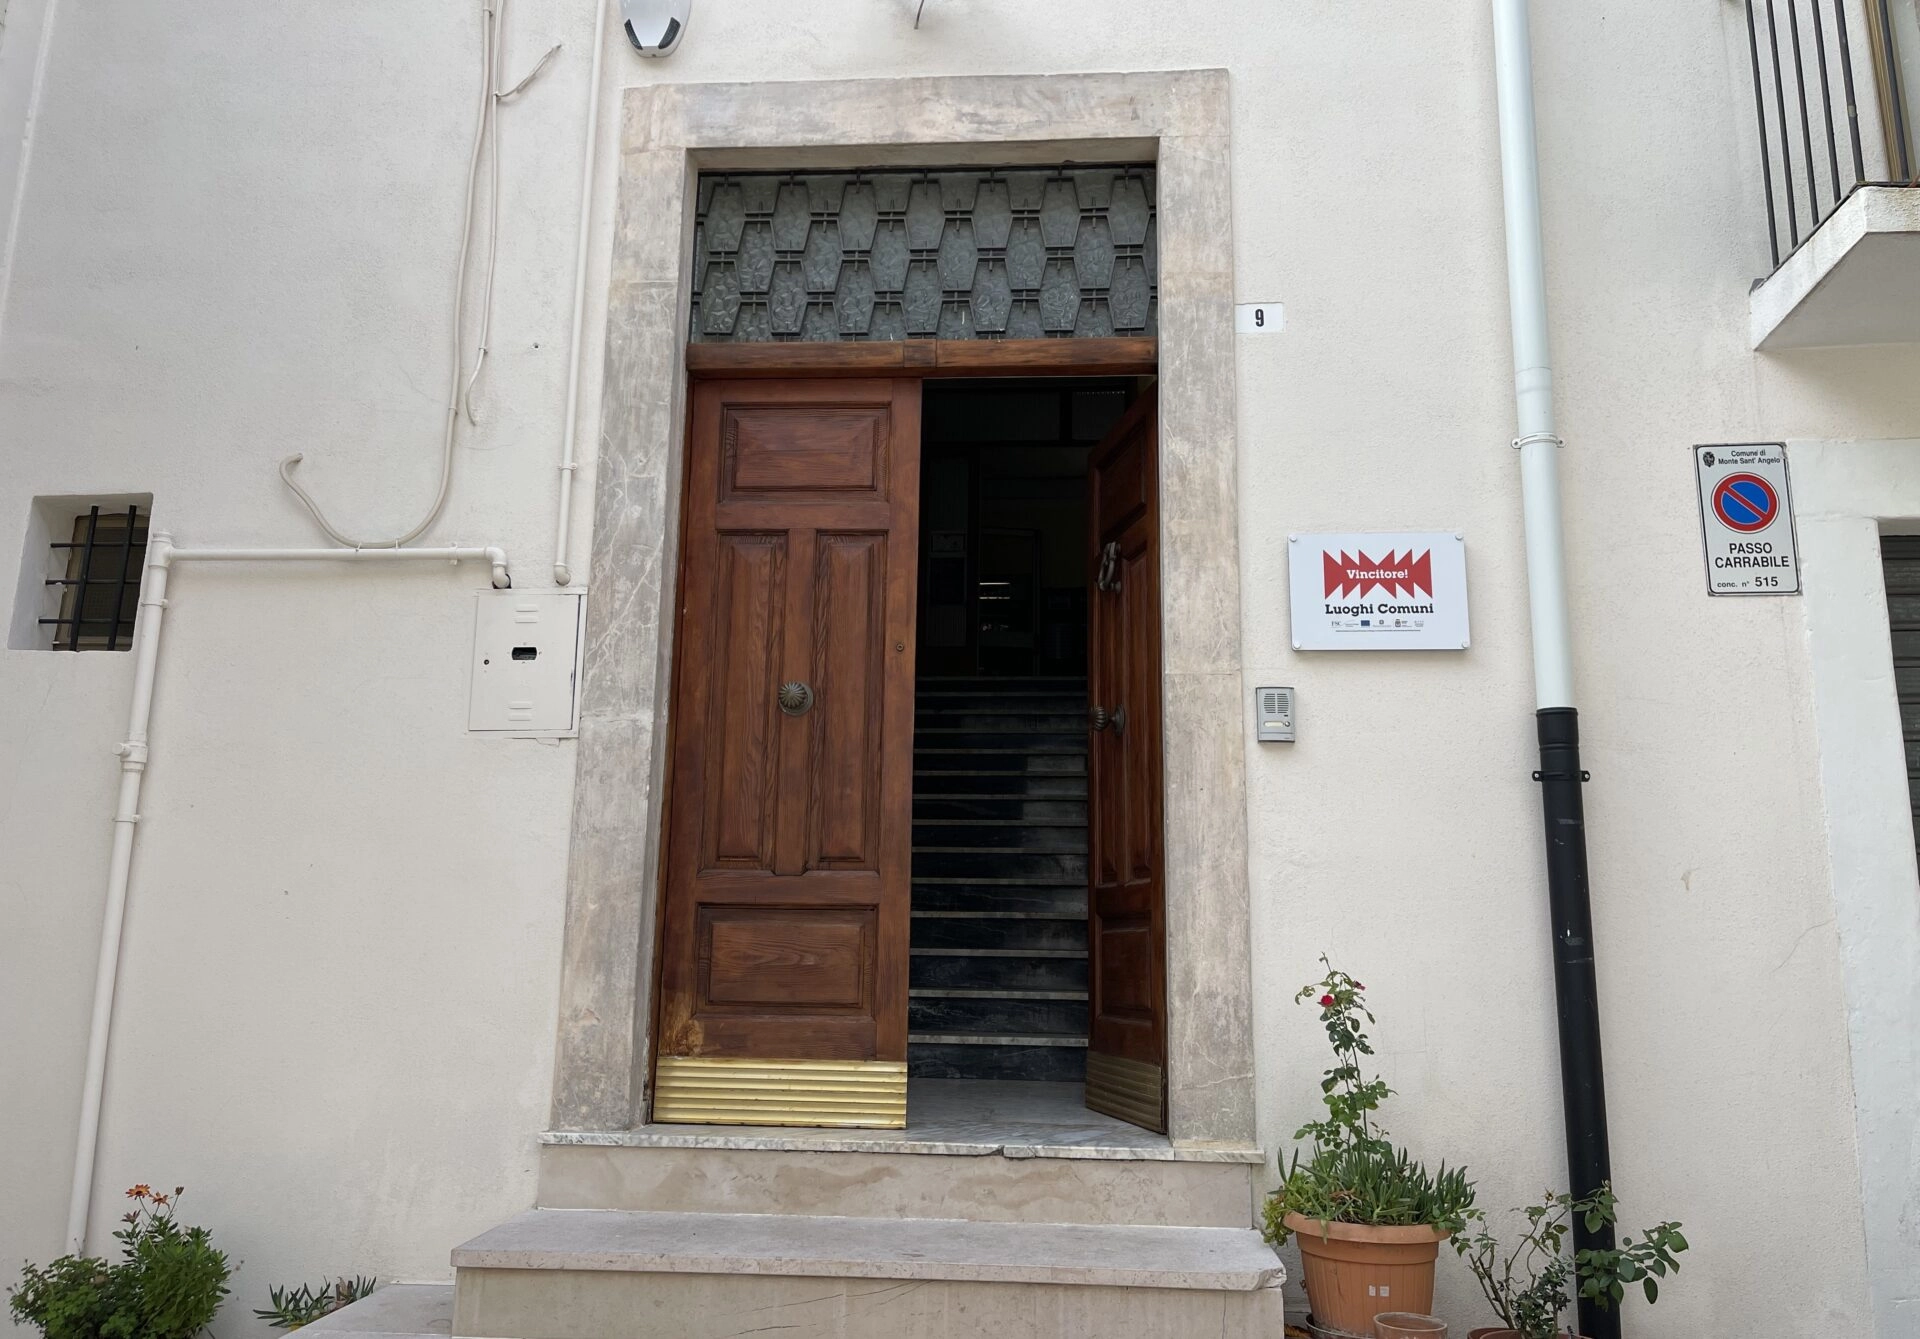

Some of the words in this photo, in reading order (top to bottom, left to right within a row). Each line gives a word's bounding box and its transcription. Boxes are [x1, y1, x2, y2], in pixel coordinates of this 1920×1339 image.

[1255, 308, 1264, 327] 9
[1758, 457, 1781, 465] Angelo
[1729, 542, 1773, 554] PASSO
[1715, 556, 1790, 568] CARRABILE
[1346, 569, 1409, 579] Vincitore!
[1754, 576, 1779, 587] 515
[1325, 604, 1374, 617] Luoghi
[1377, 603, 1434, 614] Comuni
